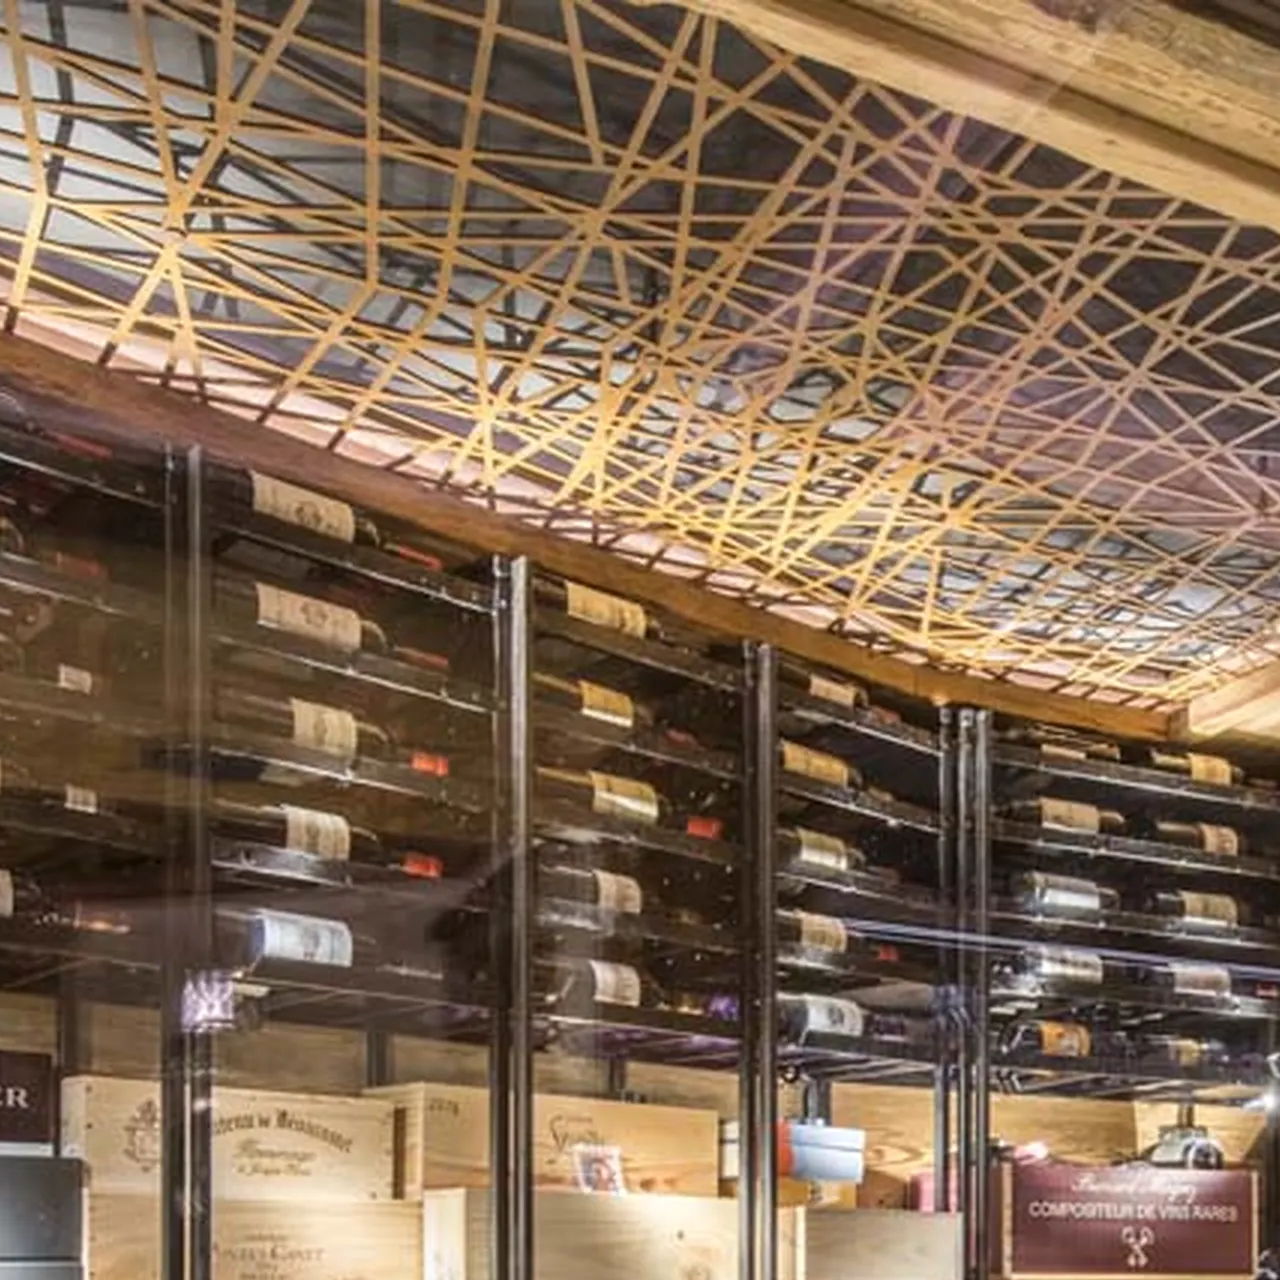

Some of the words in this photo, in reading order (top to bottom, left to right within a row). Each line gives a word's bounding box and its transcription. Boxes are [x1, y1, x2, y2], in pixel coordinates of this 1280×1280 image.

[1028, 1200, 1134, 1220] COMPOSITEUR
[1137, 1203, 1156, 1220] DE
[1190, 1204, 1238, 1223] RARES
